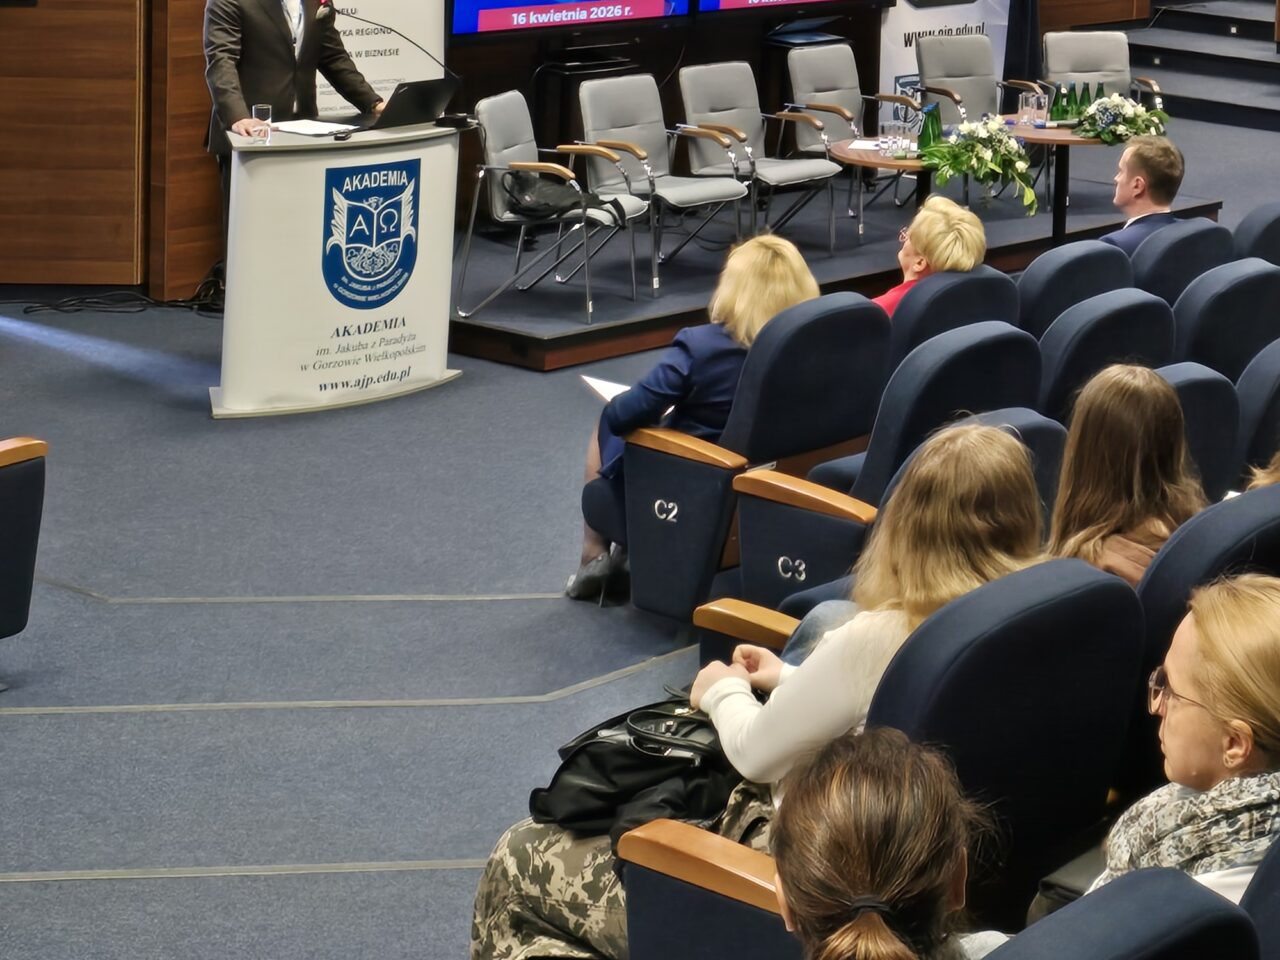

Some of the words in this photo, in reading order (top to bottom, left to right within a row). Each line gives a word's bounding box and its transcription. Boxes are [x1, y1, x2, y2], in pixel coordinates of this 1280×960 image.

[512, 13, 526, 25] 16
[529, 8, 587, 25] kwietnia
[590, 5, 621, 20] 2026
[624, 6, 633, 16] r.
[342, 170, 409, 194] AKADEMIA
[330, 316, 406, 339] AKADEMIA
[316, 345, 331, 356] im.
[335, 341, 368, 355] Jakuba
[300, 363, 309, 372] w
[312, 357, 361, 371] Gorzowie
[319, 365, 412, 392] www.ajp.edu.pl
[654, 499, 679, 523] C2
[777, 555, 806, 581] C3
